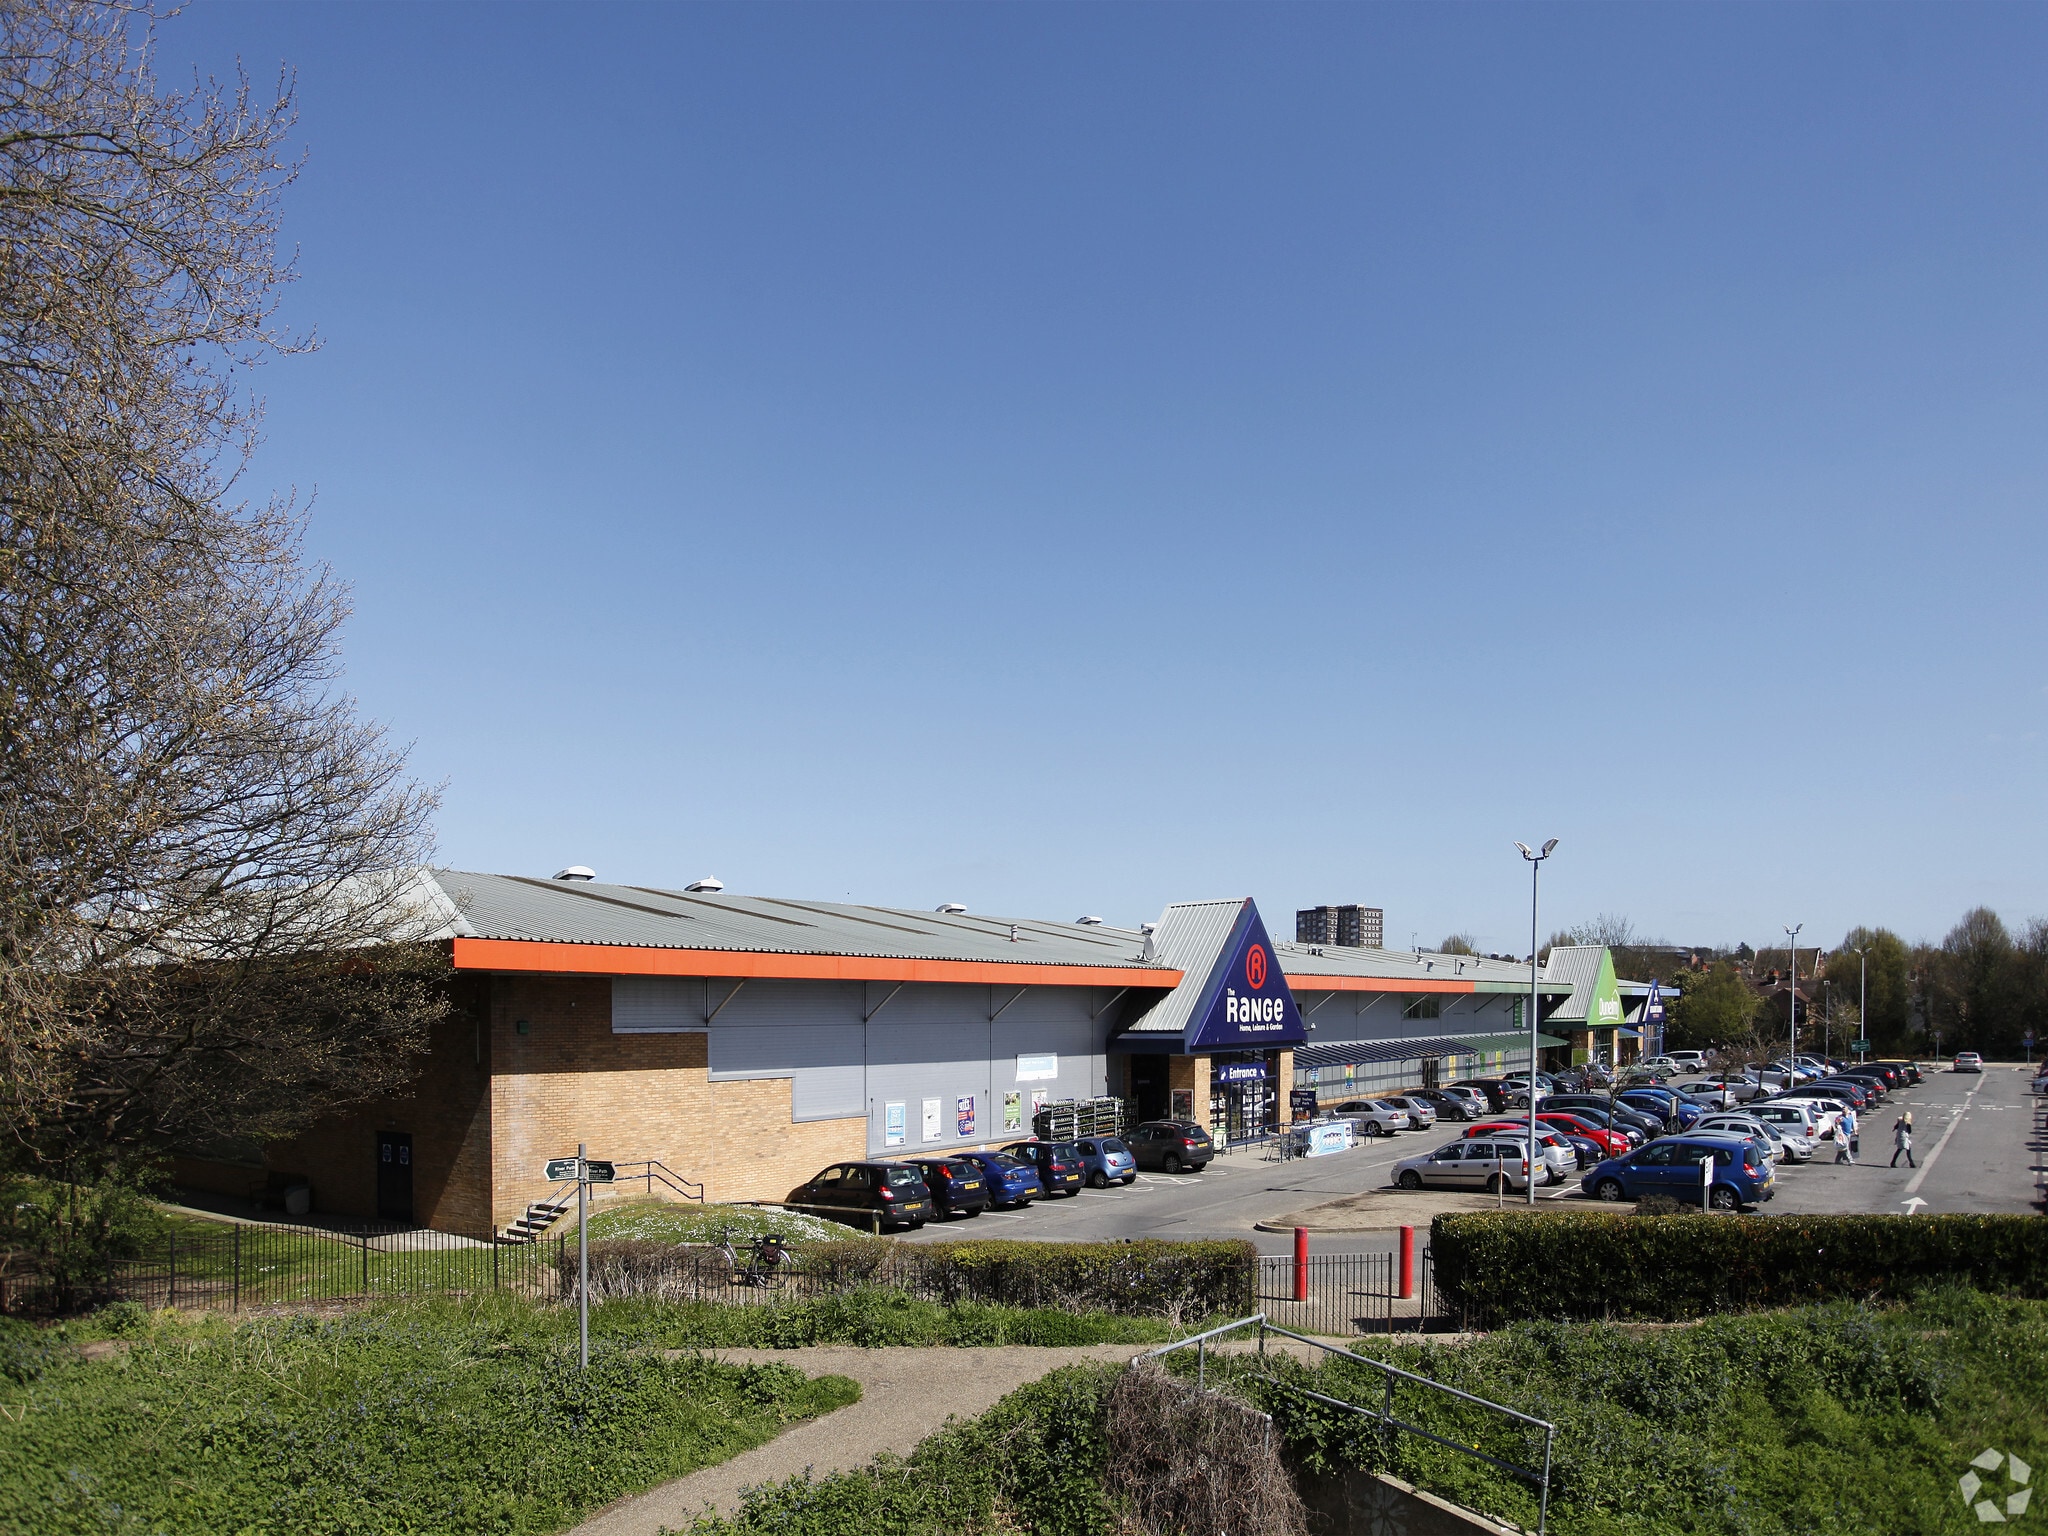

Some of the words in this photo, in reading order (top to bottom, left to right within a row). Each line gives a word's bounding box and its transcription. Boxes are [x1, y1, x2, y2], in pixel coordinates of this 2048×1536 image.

[1227, 988, 1236, 996] The
[1252, 1023, 1266, 1031] Leisure
[1270, 1022, 1283, 1030] Garden
[1229, 1067, 1257, 1079] Entrance
